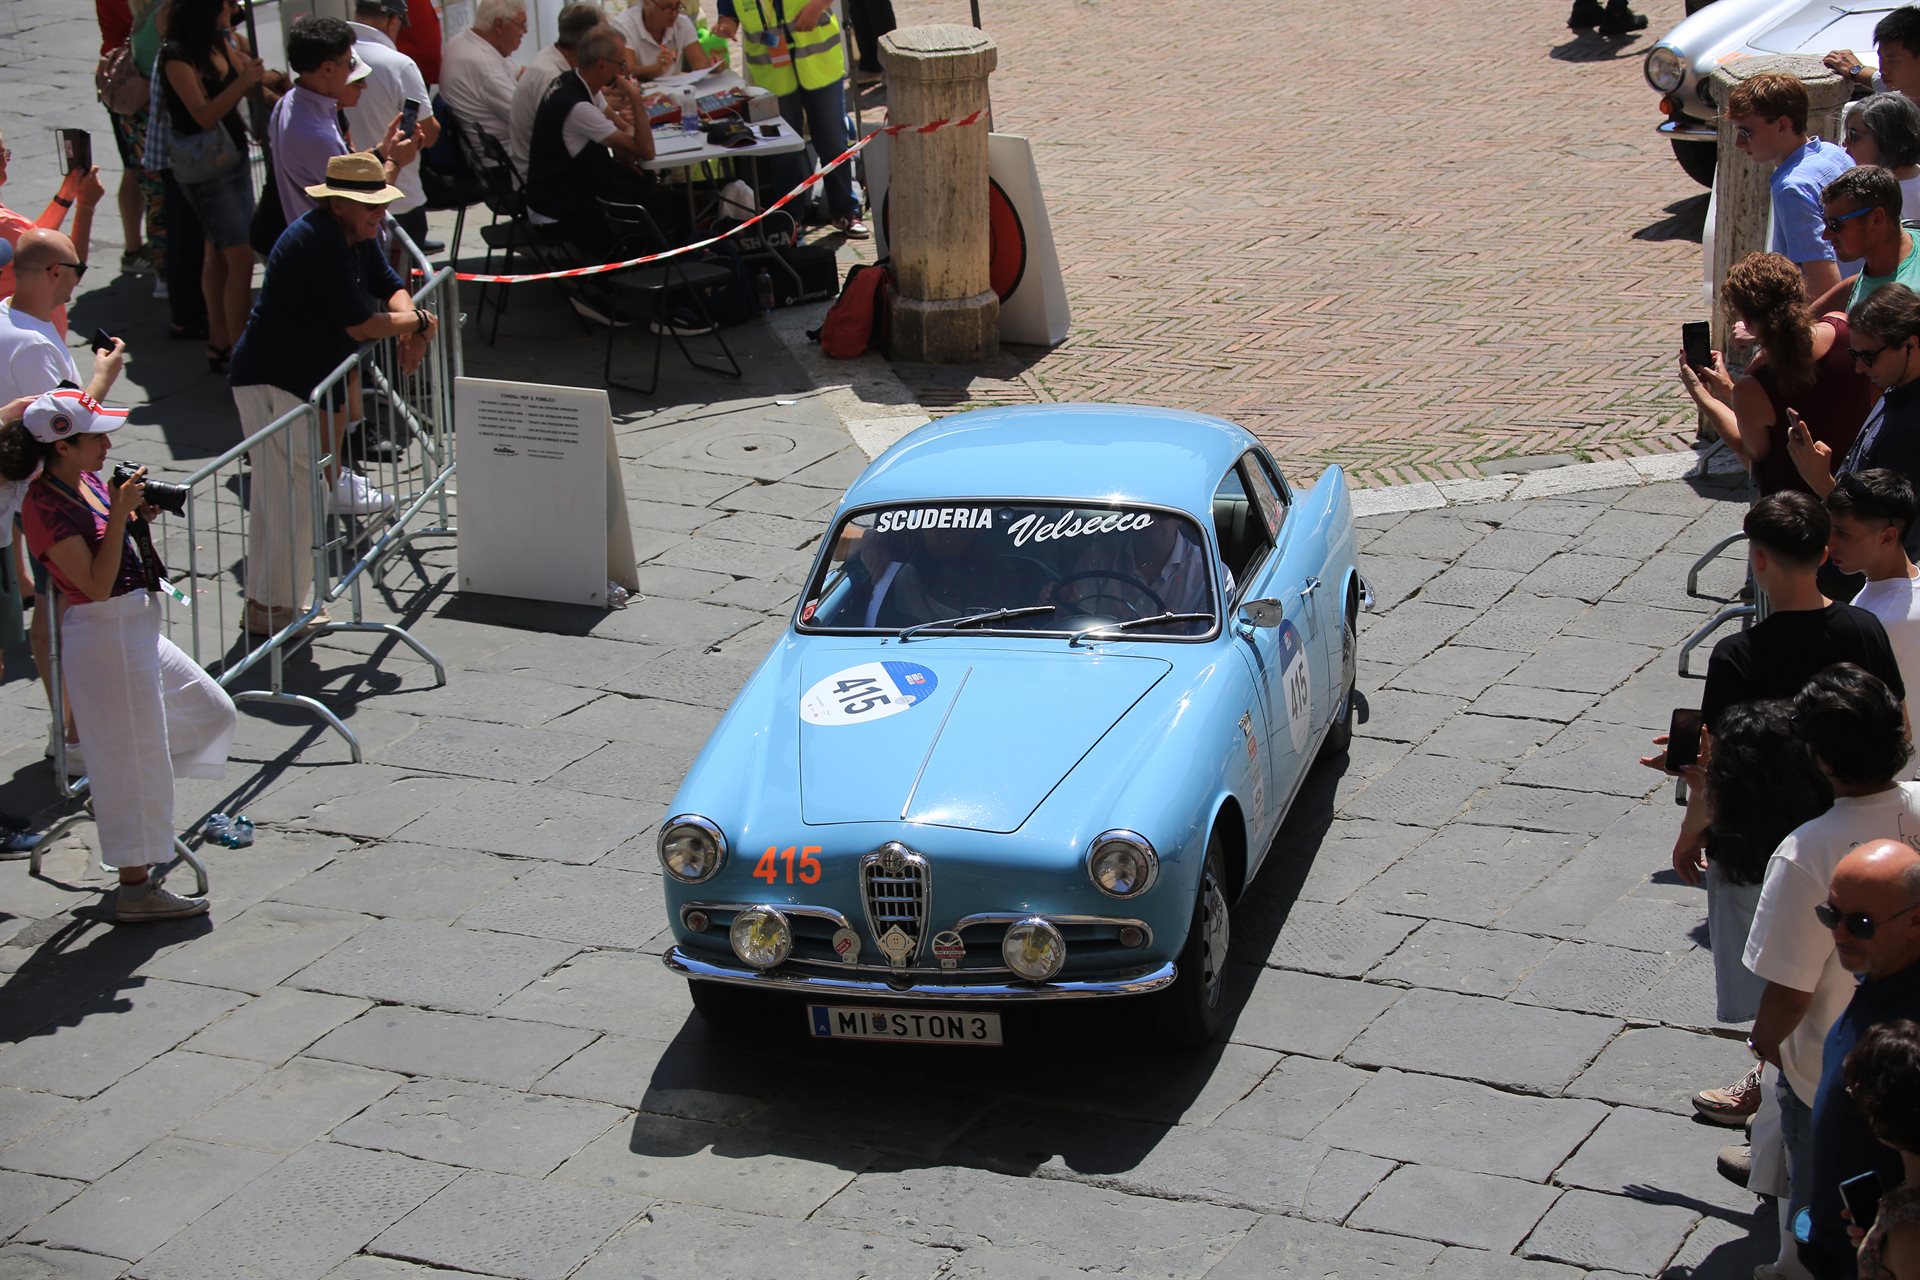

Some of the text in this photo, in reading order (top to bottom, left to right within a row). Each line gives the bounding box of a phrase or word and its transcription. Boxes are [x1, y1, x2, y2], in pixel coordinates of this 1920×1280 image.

[877, 508, 1155, 548] SCUDERIA Velsecco
[833, 677, 891, 714] 415
[1290, 661, 1308, 720] 415
[753, 846, 822, 885] 415
[838, 1012, 867, 1034] MI
[893, 1014, 964, 1039] STON
[972, 1017, 987, 1040] 3
